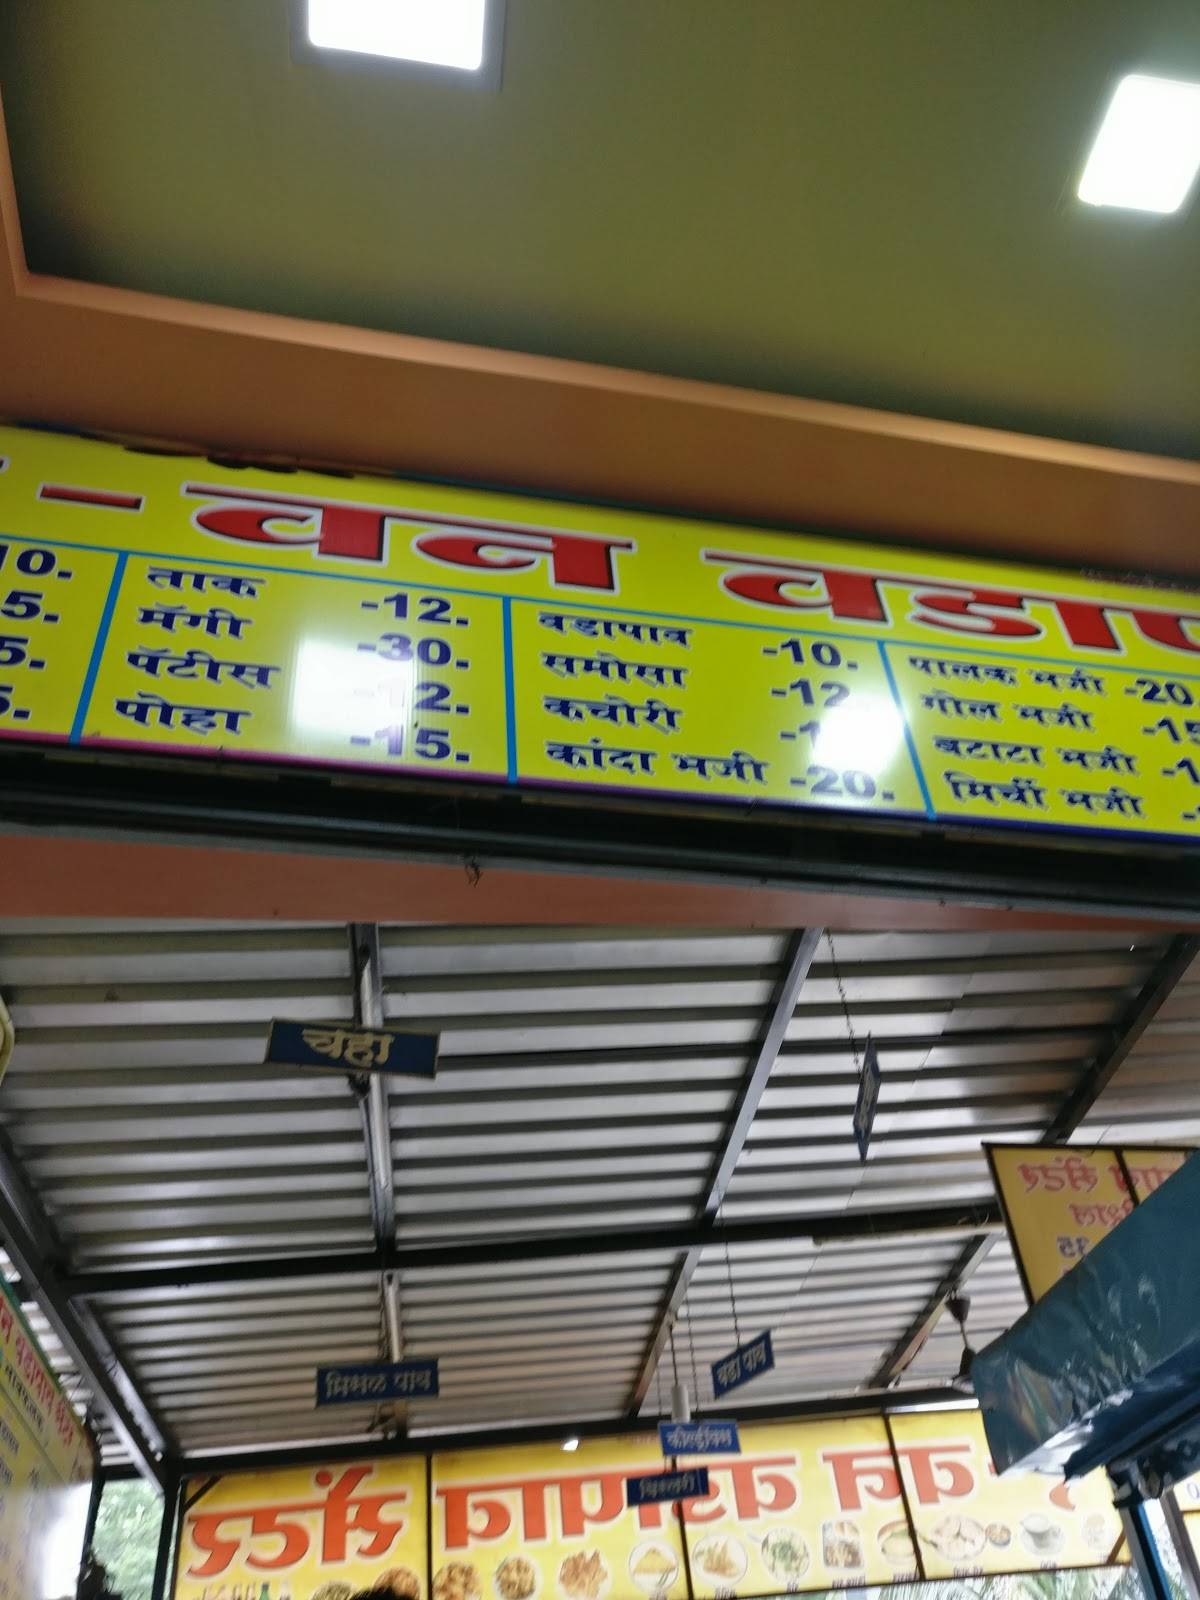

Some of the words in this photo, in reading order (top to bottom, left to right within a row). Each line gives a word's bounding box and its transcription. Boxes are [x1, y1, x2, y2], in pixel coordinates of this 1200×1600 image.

[181, 481, 637, 594] वन
[147, 565, 266, 600] ताक
[538, 611, 694, 649] वडापाव
[540, 650, 690, 689] समोसा
[908, 656, 1018, 686] पालक
[1028, 667, 1106, 696] भजी
[114, 689, 253, 736] पोहा
[542, 693, 682, 736] कचोरी
[920, 688, 1003, 722] गोल
[1012, 702, 1095, 732] भजी
[545, 737, 659, 776] कांदा
[672, 750, 771, 785] भजी
[933, 735, 1046, 768] बटाटा
[1055, 744, 1140, 775] भजी
[1058, 785, 1147, 818] भजी
[301, 1028, 395, 1068] चहा
